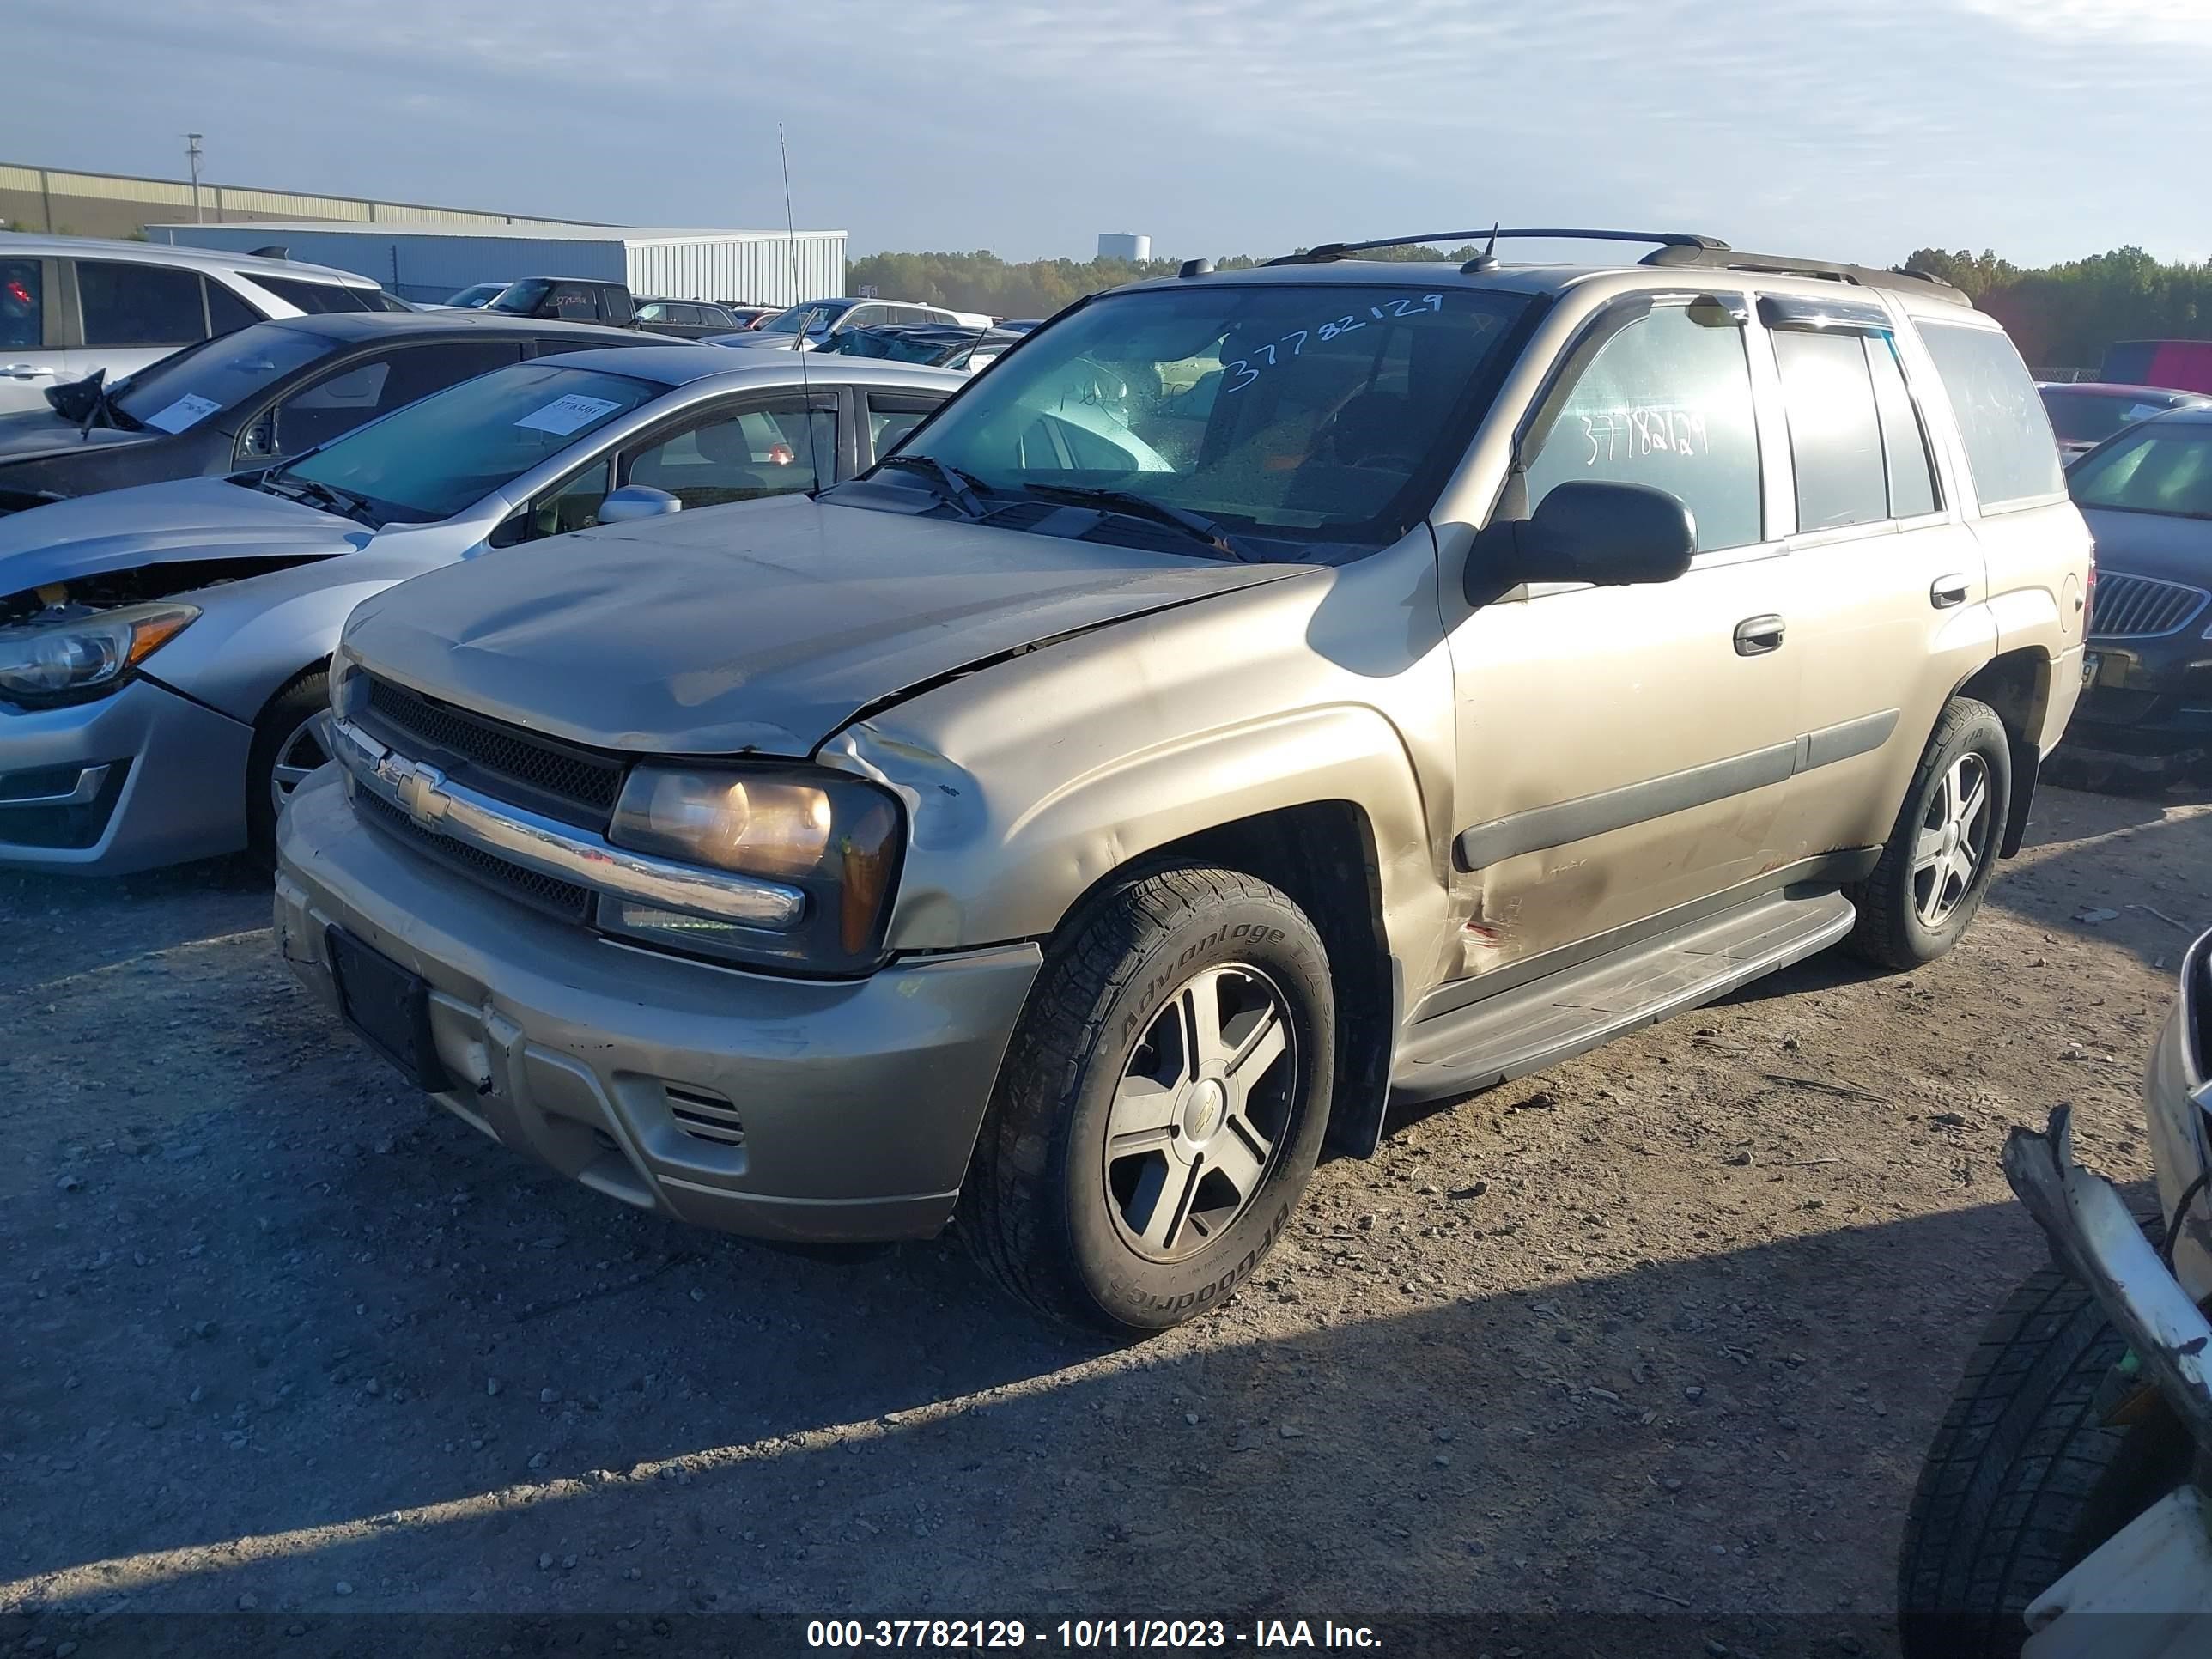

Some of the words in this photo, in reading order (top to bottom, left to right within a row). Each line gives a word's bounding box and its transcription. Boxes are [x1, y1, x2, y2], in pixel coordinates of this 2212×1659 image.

[1224, 293, 1443, 392] 37782129
[1580, 407, 1709, 466] 37782129
[1120, 922, 1286, 1052] Advantage
[1289, 941, 1325, 997] T/A
[1110, 1202, 1290, 1314] BFGoodrich
